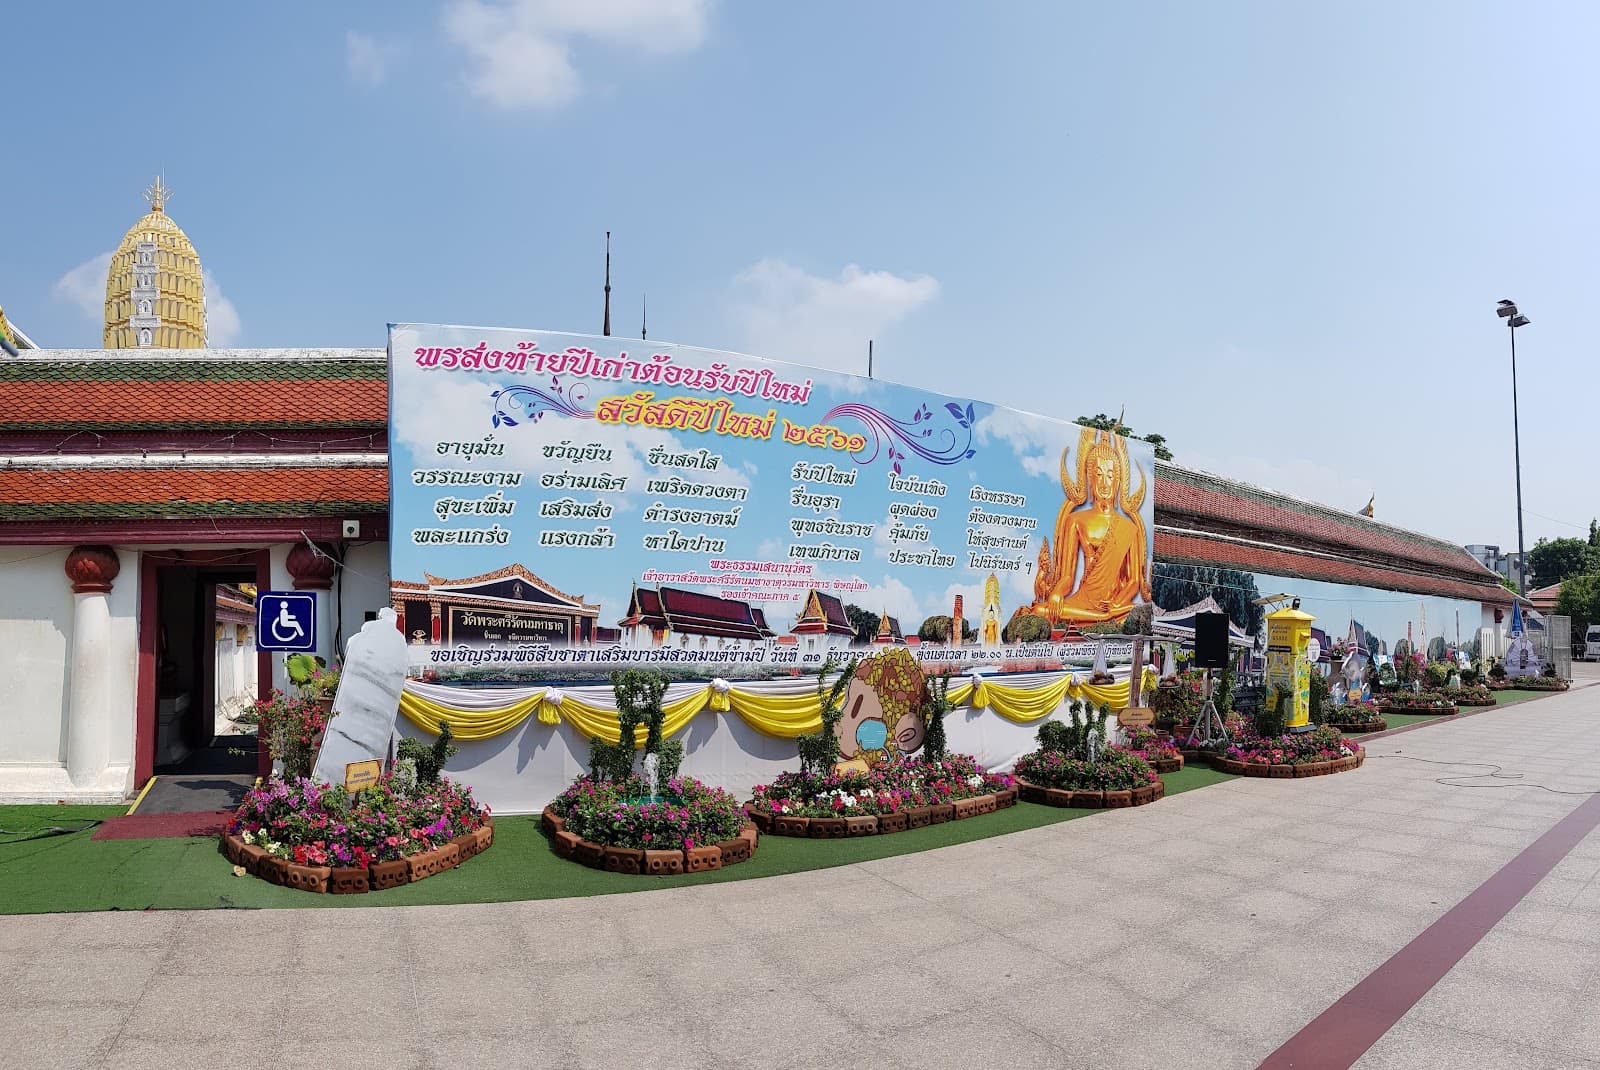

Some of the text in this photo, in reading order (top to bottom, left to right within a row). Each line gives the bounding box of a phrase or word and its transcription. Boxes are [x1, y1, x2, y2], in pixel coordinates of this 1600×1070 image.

[414, 342, 812, 402] พรส่งท้ายปีเก่าต้อนรับปีใหม่
[598, 393, 868, 451] สวัสดีปีใหม่ ๒๕๖๑
[436, 433, 1025, 507] อายุมั่น ขวัญยืน ชื่นสดใส รับปีใหม่ ใจบันเทิง เริงหรรษา
[413, 470, 522, 486] วรรณะงาม
[541, 470, 628, 490] อร่ามเลิศ
[791, 486, 840, 512] รื่นอุรา
[890, 502, 937, 519] ผุดผ่อง
[968, 510, 1037, 529] ต้องดวงมาน
[435, 492, 515, 520] สุขะเพิ่ม
[541, 499, 612, 519] เสริมส่ง
[790, 517, 874, 537] พุทธชินราช
[888, 524, 930, 543] คุ้มภัย
[413, 526, 510, 544] พละแกร่ง
[541, 528, 615, 547] แรงกล้า
[644, 529, 725, 552] หาใดปาน
[789, 544, 861, 561] เทพภิบาล
[889, 549, 956, 568] ประชาไทย
[969, 552, 1022, 571] ไปนิรันดร์
[709, 559, 813, 577] พระธรรมเสนานุวัตร
[460, 612, 564, 635] วัดพระศรีรัตนมหาธาตุ
[430, 644, 766, 666] ขอเชิญร่วมพิธีสืบชาตาเสริมบารมีสวดมนต์ข้ามปี
[770, 643, 799, 663] วันที่
[802, 653, 821, 663] ๓๑
[916, 641, 968, 661] ตั้งแต่เวลา
[971, 650, 1002, 660] ๒๒.๐๐
